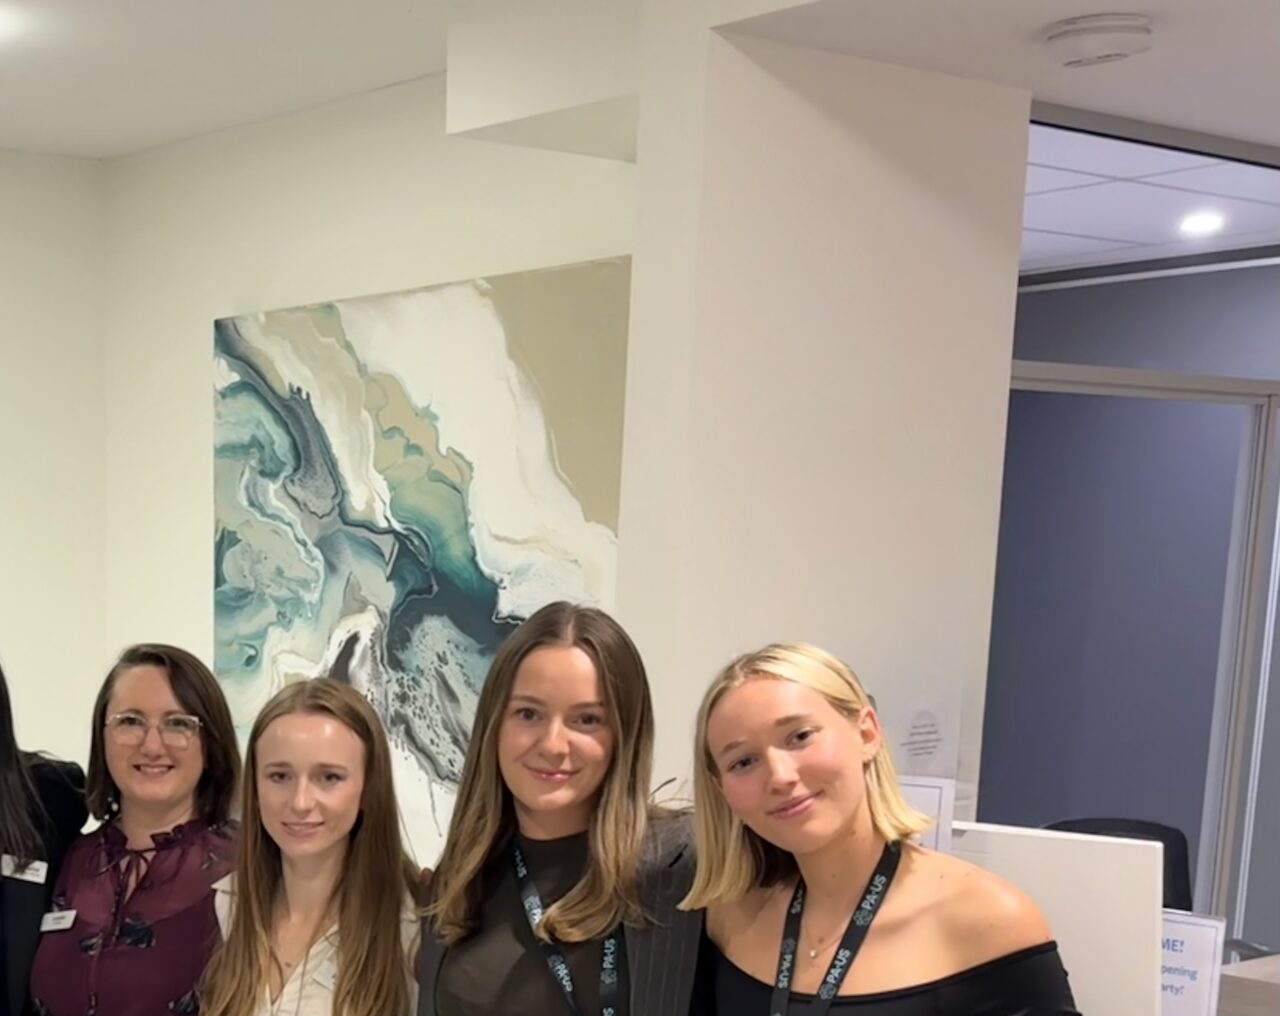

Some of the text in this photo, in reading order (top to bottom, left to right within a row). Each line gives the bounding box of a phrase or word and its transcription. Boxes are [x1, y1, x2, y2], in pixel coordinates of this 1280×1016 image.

[862, 874, 887, 911] PA-US
[603, 938, 616, 969] PA-US
[827, 948, 851, 984] PA-US
[778, 954, 793, 989] PA-US
